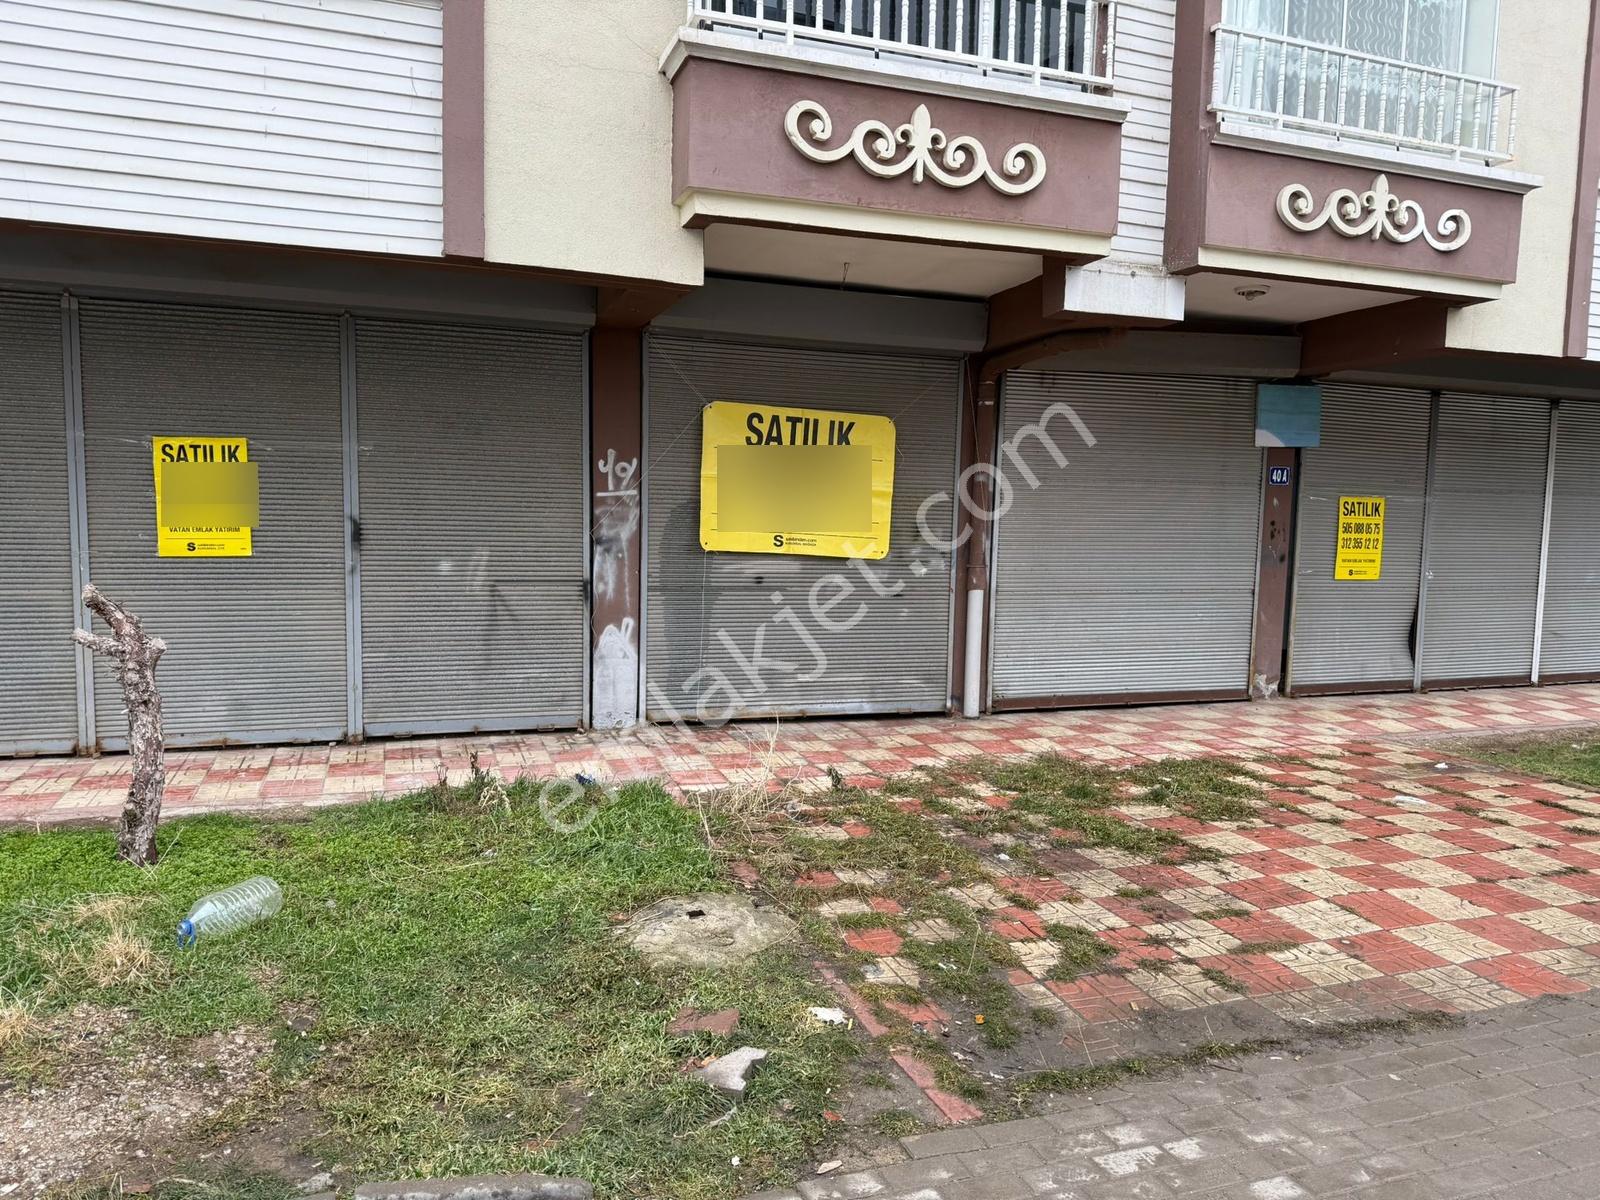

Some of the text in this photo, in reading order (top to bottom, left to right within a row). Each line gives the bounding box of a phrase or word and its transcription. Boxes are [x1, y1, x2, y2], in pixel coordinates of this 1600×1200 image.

[1272, 469, 1282, 482] 40
[1343, 501, 1381, 517] SATILIK
[1342, 522, 1353, 534] 505
[1341, 537, 1352, 549] 312
[1364, 537, 1371, 550] 12
[1372, 538, 1380, 550] 12
